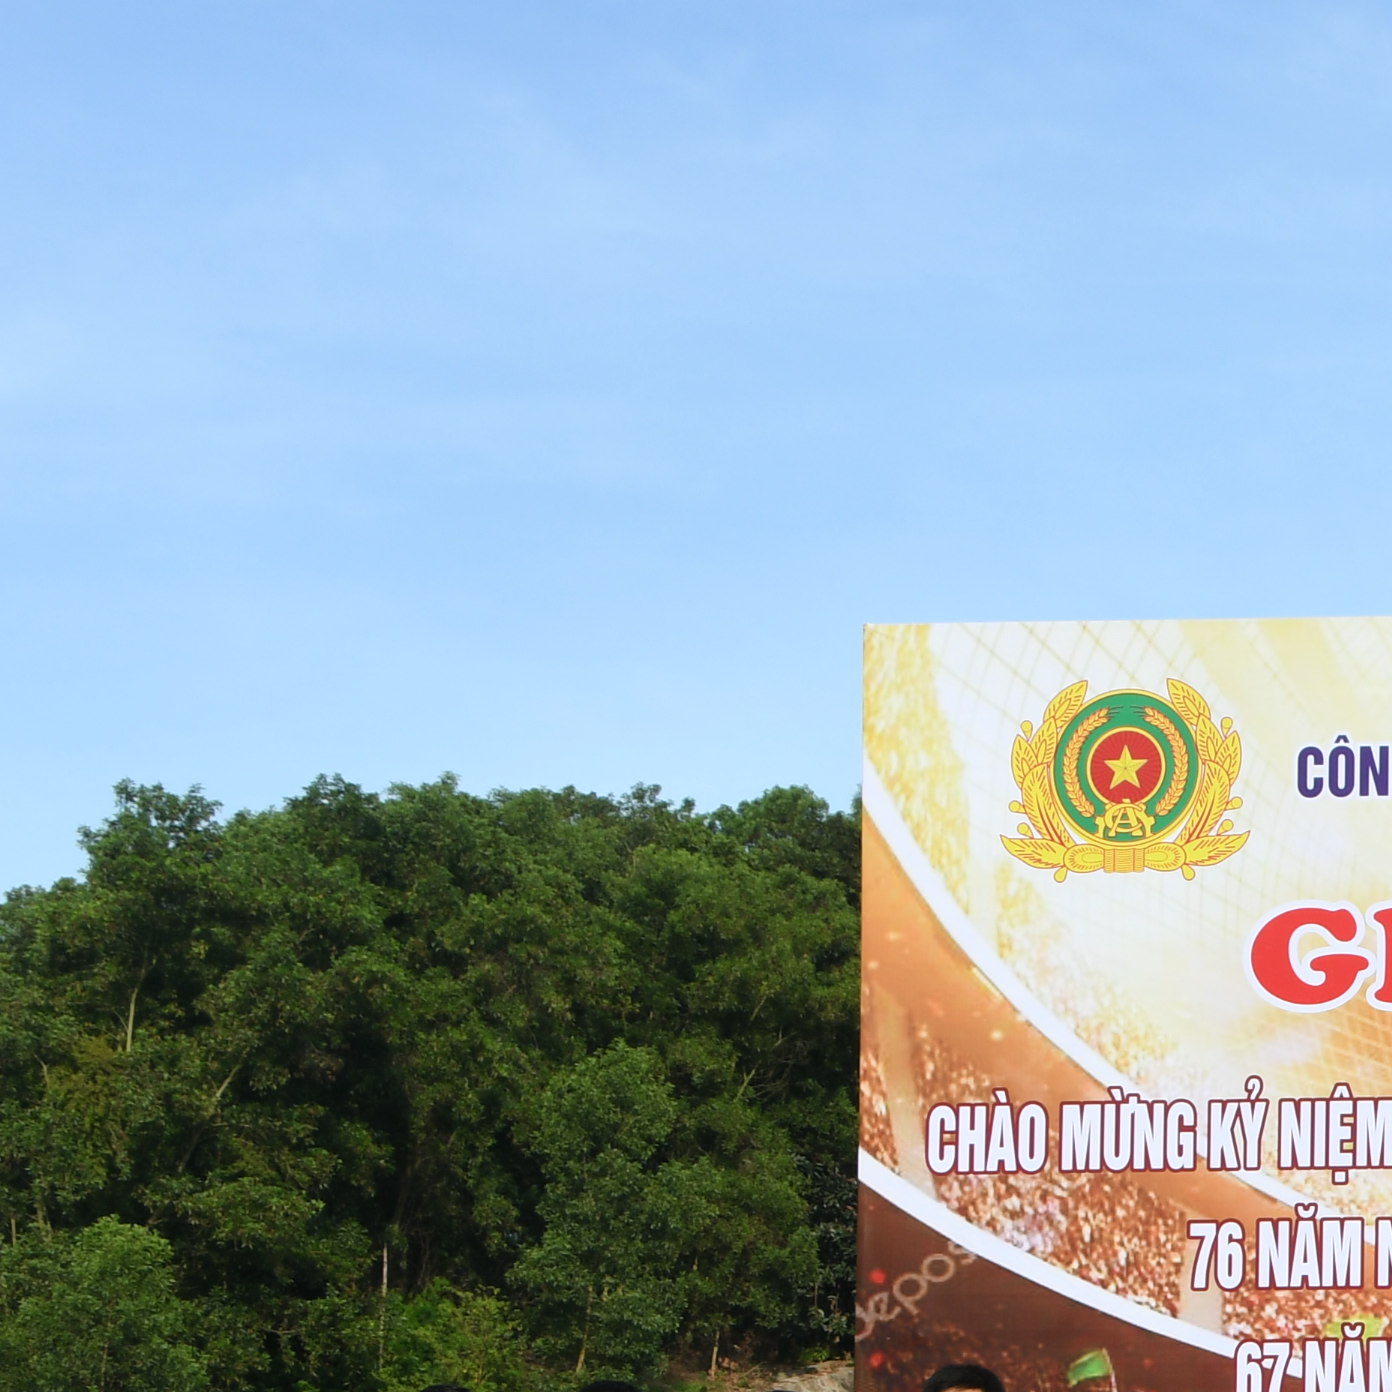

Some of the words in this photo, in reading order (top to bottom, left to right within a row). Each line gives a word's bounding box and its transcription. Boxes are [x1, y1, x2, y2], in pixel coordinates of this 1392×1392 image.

[927, 1091, 1048, 1174] CHÀO
[1060, 1088, 1197, 1172] MỪNG
[1207, 1076, 1270, 1170] KỶ
[1188, 1218, 1244, 1290] 76
[1256, 1203, 1364, 1288] NĂM
